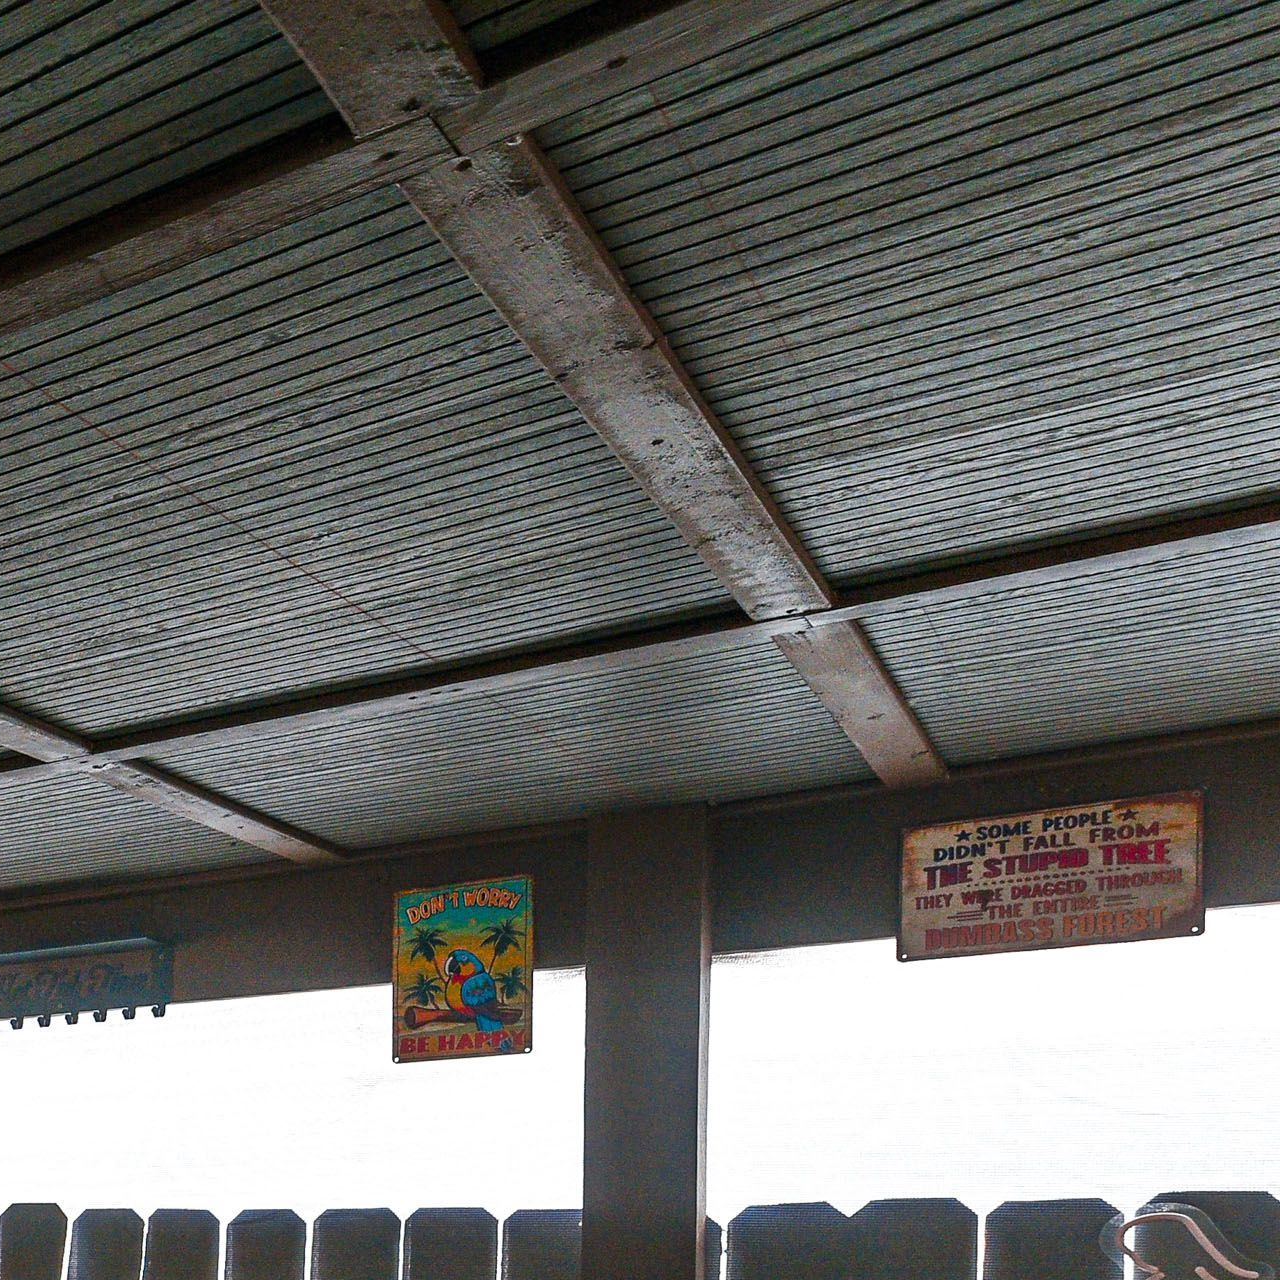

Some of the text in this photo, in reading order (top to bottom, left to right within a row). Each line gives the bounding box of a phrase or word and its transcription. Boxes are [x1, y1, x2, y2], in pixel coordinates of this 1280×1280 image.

[933, 820, 1161, 862] DIDN'T FALL FROM
[976, 809, 1113, 841] SOME PEOPLE
[923, 838, 1172, 891] THE STUPID TREE
[406, 887, 524, 925] DON'T WORRY
[914, 893, 953, 910] THEY
[1010, 878, 1088, 900] DRAGGED
[1096, 867, 1183, 892] THROUGH
[988, 895, 1100, 920] THE ENTIRE
[925, 906, 1167, 951] DUMBASS FOREST
[400, 1029, 528, 1054] BE HAPPY
